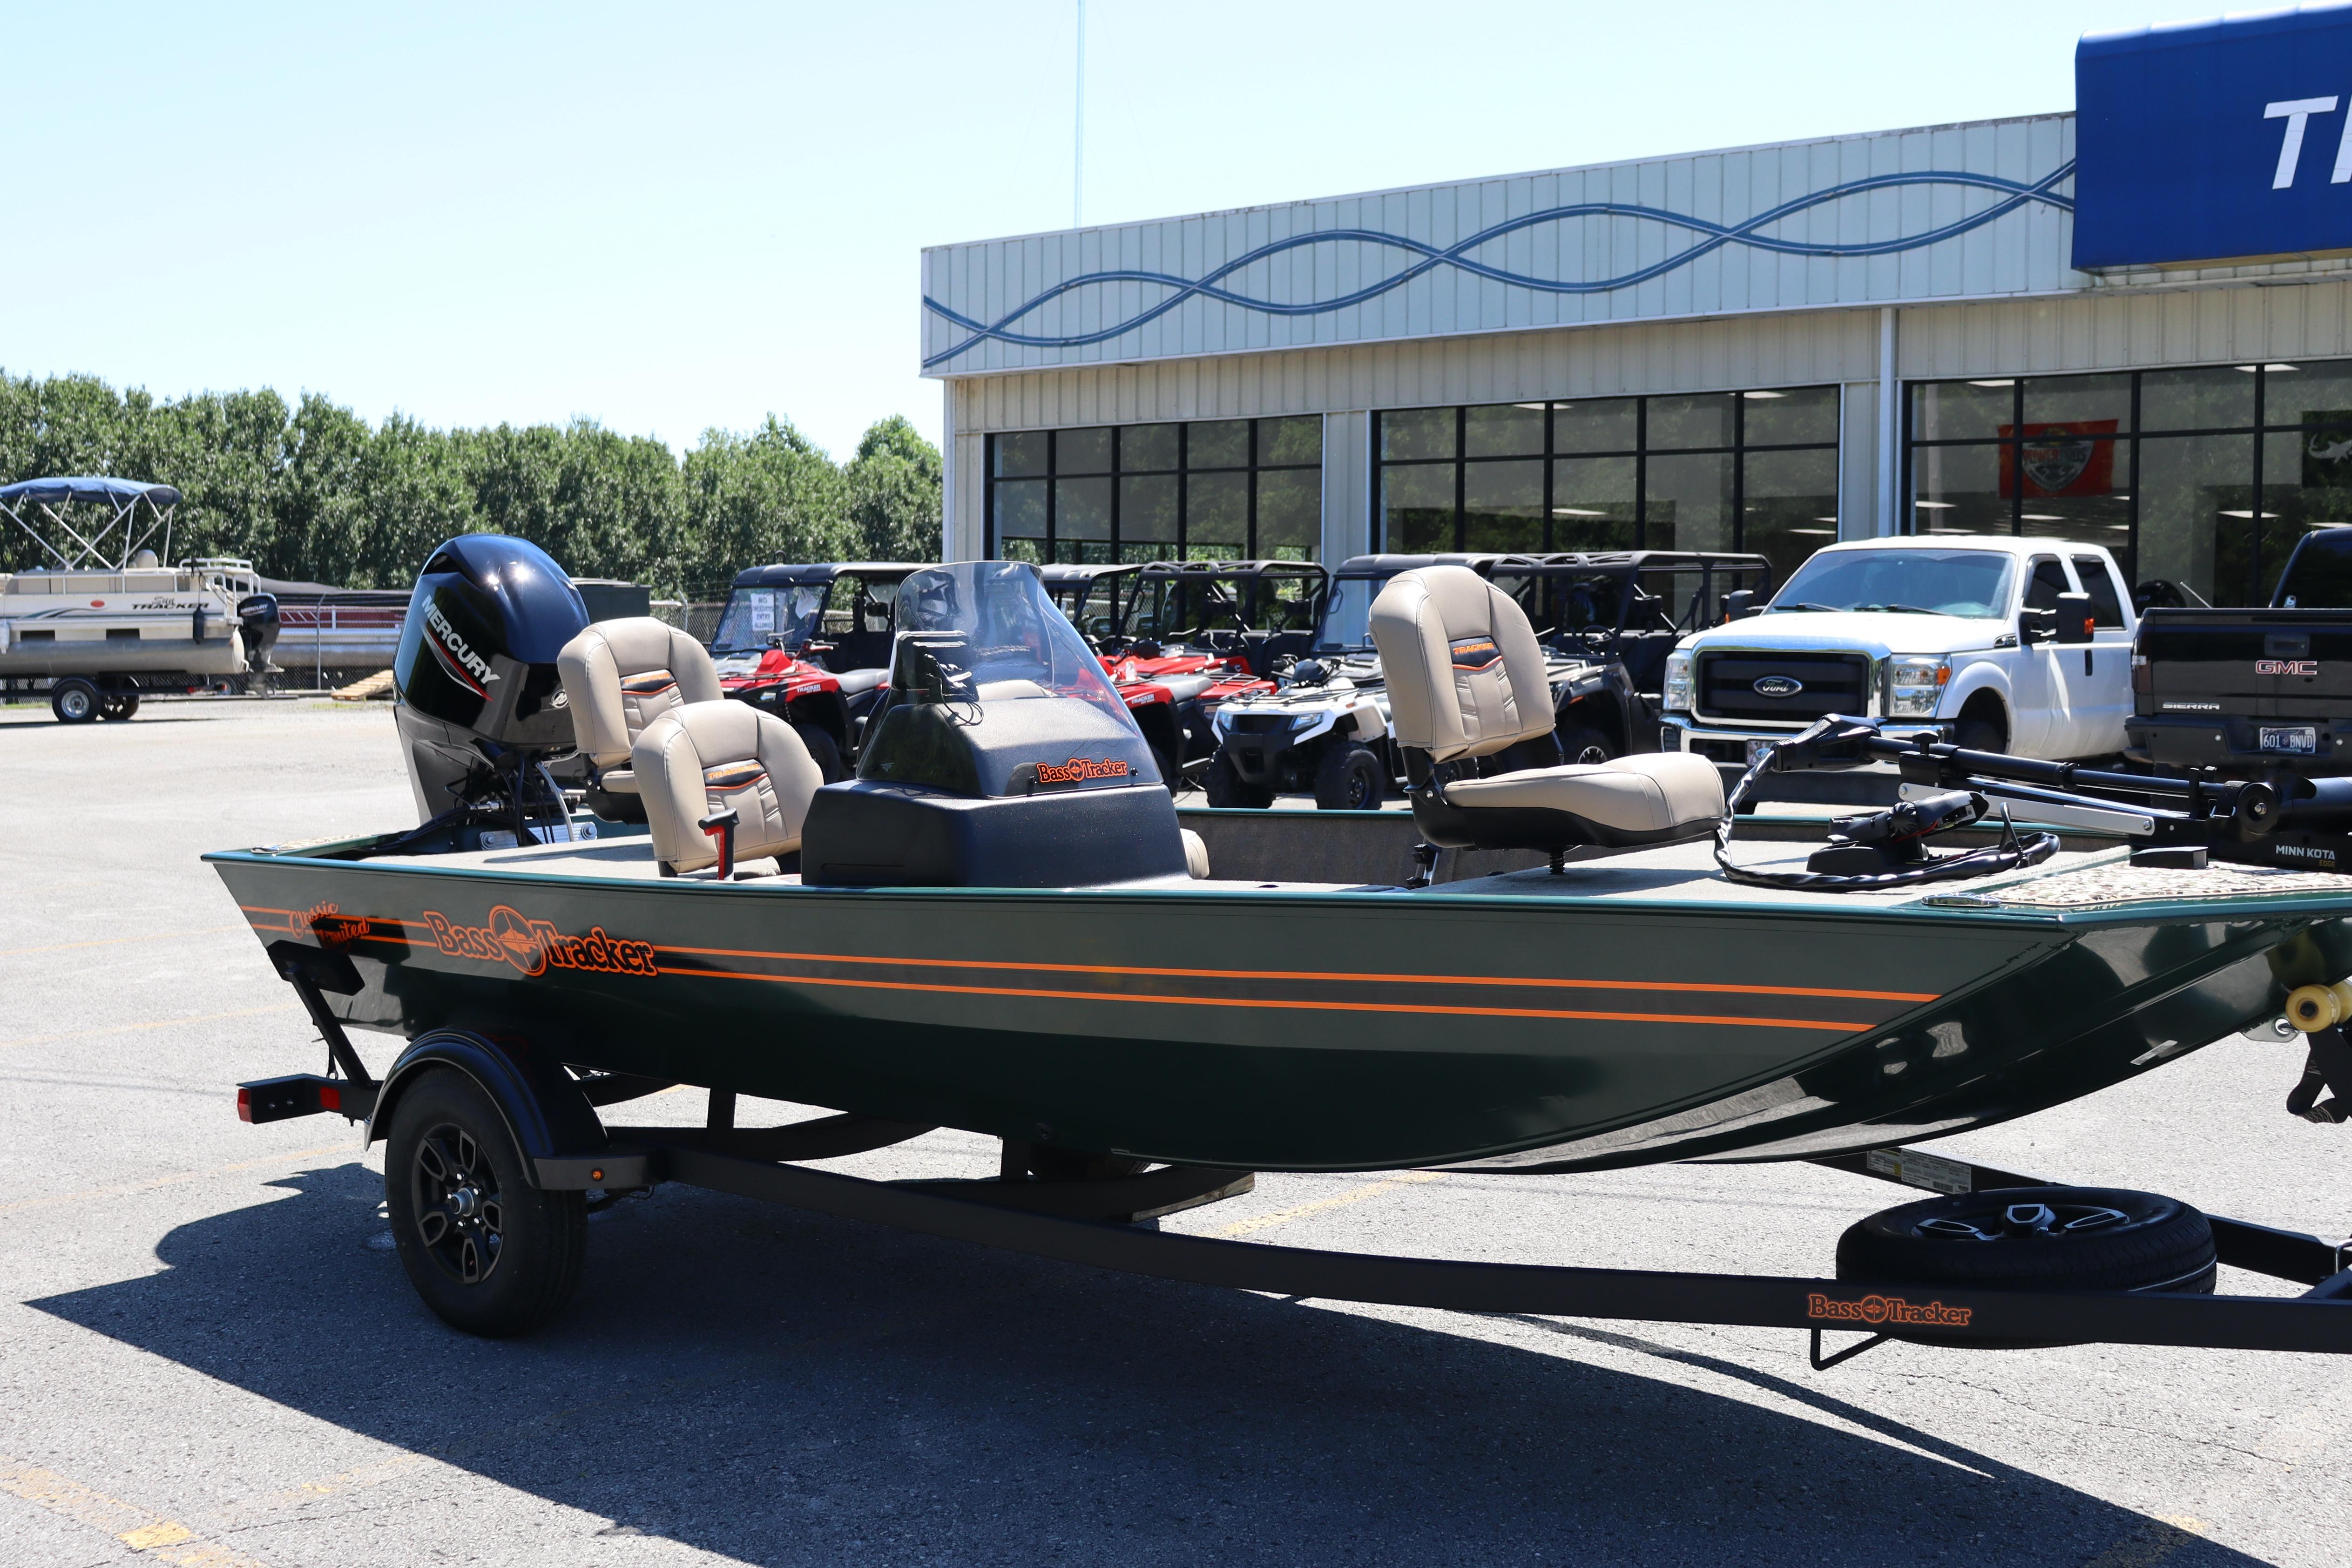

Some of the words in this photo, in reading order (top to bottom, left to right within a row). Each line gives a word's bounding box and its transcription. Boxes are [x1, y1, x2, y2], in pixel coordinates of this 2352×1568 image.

[2264, 95, 2352, 189] T
[240, 604, 268, 614] MERCURY
[421, 594, 501, 684] MERCURY
[1453, 642, 1494, 656] TRACKER
[2256, 660, 2317, 675] GMC
[624, 672, 670, 685] TRACKER
[1762, 679, 1789, 692] Ford
[796, 683, 821, 693] TRACKER
[1131, 694, 1155, 704] TRACKER
[2264, 735, 2281, 748] 601
[2289, 735, 2313, 748] BNVD
[707, 763, 761, 780] TRACKER
[1036, 762, 1071, 783] Bass
[1080, 757, 1128, 778] Tracker
[2276, 845, 2305, 857] MINN
[2306, 848, 2336, 860] KOTA
[289, 900, 339, 939] Classic
[423, 911, 506, 961] Bass
[528, 919, 658, 976] Tracker
[1809, 1294, 1863, 1319] Bass
[1886, 1298, 1972, 1326] Tracker
